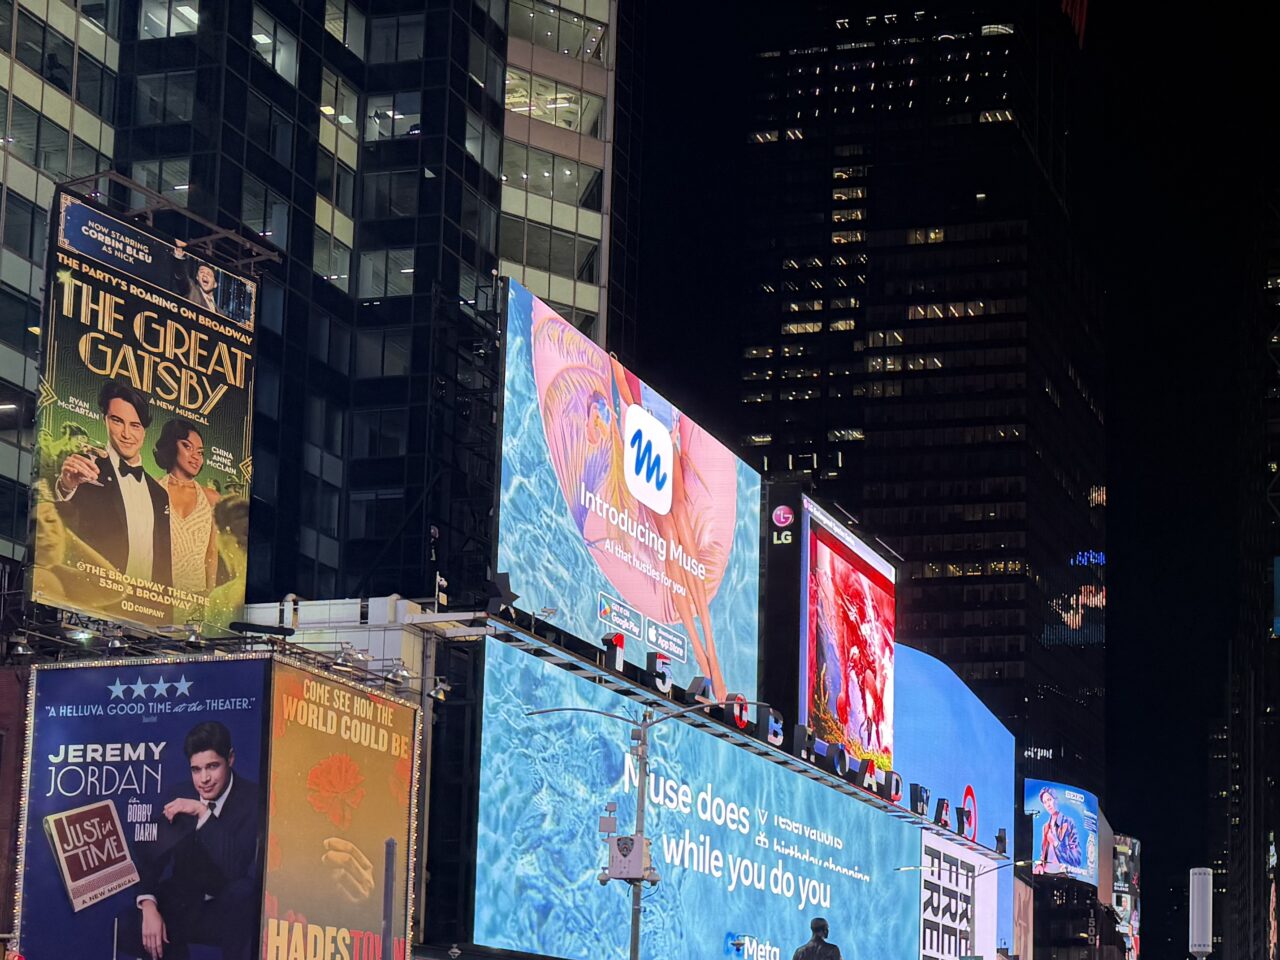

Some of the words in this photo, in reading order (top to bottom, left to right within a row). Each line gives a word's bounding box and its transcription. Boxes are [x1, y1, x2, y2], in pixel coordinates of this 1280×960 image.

[81, 225, 123, 251] CORBIN
[126, 243, 152, 263] BLEU
[88, 220, 109, 235] NOW
[110, 230, 149, 253] STARRING
[101, 245, 112, 255] AS
[114, 250, 134, 264] NICK
[56, 253, 79, 270] THE
[82, 264, 128, 291] PARTY'S
[130, 284, 178, 312] ROARING
[180, 308, 196, 321] ON
[199, 315, 253, 345] BROADWAY
[62, 277, 125, 338] THE
[133, 311, 252, 389] GREAT
[79, 332, 228, 415] GATSBY
[57, 400, 99, 420] McCARTAN
[69, 396, 89, 408] RYAN
[157, 399, 175, 412] NEW
[176, 407, 209, 425] MUSICAL
[206, 460, 236, 475] McCLAIN
[211, 447, 233, 460] CHINA
[212, 455, 231, 467] ANNE
[580, 481, 666, 561] Introducing
[670, 539, 706, 580] Muse
[773, 531, 793, 545] LG
[604, 538, 615, 552] AI
[615, 543, 631, 563] that
[633, 553, 660, 581] hustles
[660, 571, 672, 586] for
[672, 580, 687, 597] you
[99, 578, 124, 592] 53RD
[126, 586, 134, 595] &
[136, 588, 192, 610] BROADWAY
[108, 570, 165, 593] BROADWAY
[167, 586, 210, 606] THEATRE
[135, 606, 165, 618] COMPANY
[611, 612, 628, 629] Google
[658, 636, 670, 650] App
[669, 641, 684, 657] Store
[59, 705, 104, 717] HELLUVA
[107, 703, 145, 715] GOOD
[149, 702, 172, 713] TIME
[173, 702, 186, 713] at
[187, 701, 206, 712] the
[303, 678, 331, 706] COME
[333, 689, 351, 713] SEE
[353, 696, 374, 720] HOW
[377, 703, 394, 727] THE
[283, 694, 337, 735] WORLD
[341, 716, 388, 752] COULD
[392, 733, 409, 759] BE
[48, 741, 167, 763] JEREMY
[46, 764, 162, 797] JORDAN
[624, 753, 692, 813] Muse
[697, 783, 750, 834] does
[128, 804, 152, 822] BOBBY
[63, 816, 101, 851] JUST
[101, 820, 114, 836] in
[135, 824, 158, 841] DARIN
[65, 836, 126, 871] TIME
[663, 829, 724, 878] while
[728, 853, 765, 892] you
[770, 860, 795, 898] do
[798, 875, 831, 911] you
[89, 891, 106, 901] NEW
[107, 878, 136, 893] MUSICAL
[1088, 908, 1096, 945] 1500
